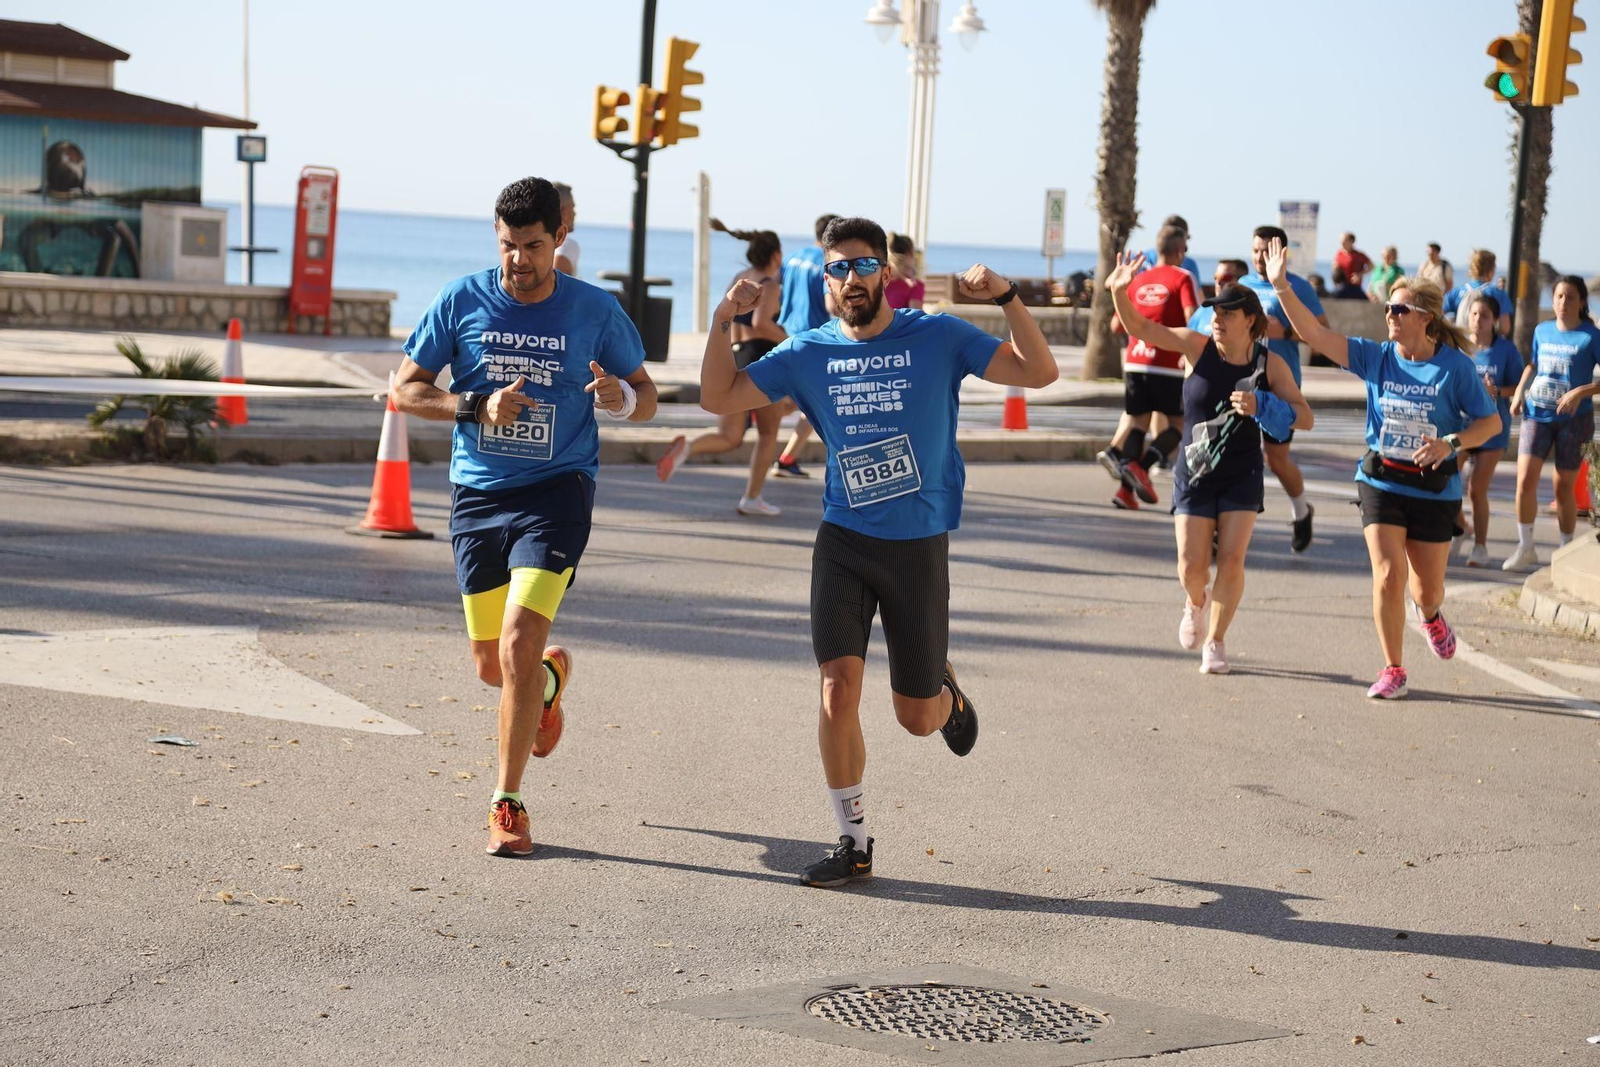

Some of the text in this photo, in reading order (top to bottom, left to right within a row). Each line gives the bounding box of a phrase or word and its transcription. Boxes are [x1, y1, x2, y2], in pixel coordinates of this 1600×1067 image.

[481, 331, 566, 351] mayoral
[481, 354, 560, 371] RUNNING
[827, 350, 911, 374] mayoral
[488, 364, 552, 378] MAKES
[486, 372, 552, 386] FRIENDS
[828, 379, 907, 395] RUNNING
[1383, 381, 1438, 396] mayoral
[836, 390, 901, 405] MAKES
[836, 401, 904, 416] FRIENDS
[493, 423, 545, 441] 1620
[881, 440, 905, 450] mayoral
[849, 454, 869, 462] Carrera
[850, 458, 875, 467] Solidaria
[851, 458, 907, 486] 1984
